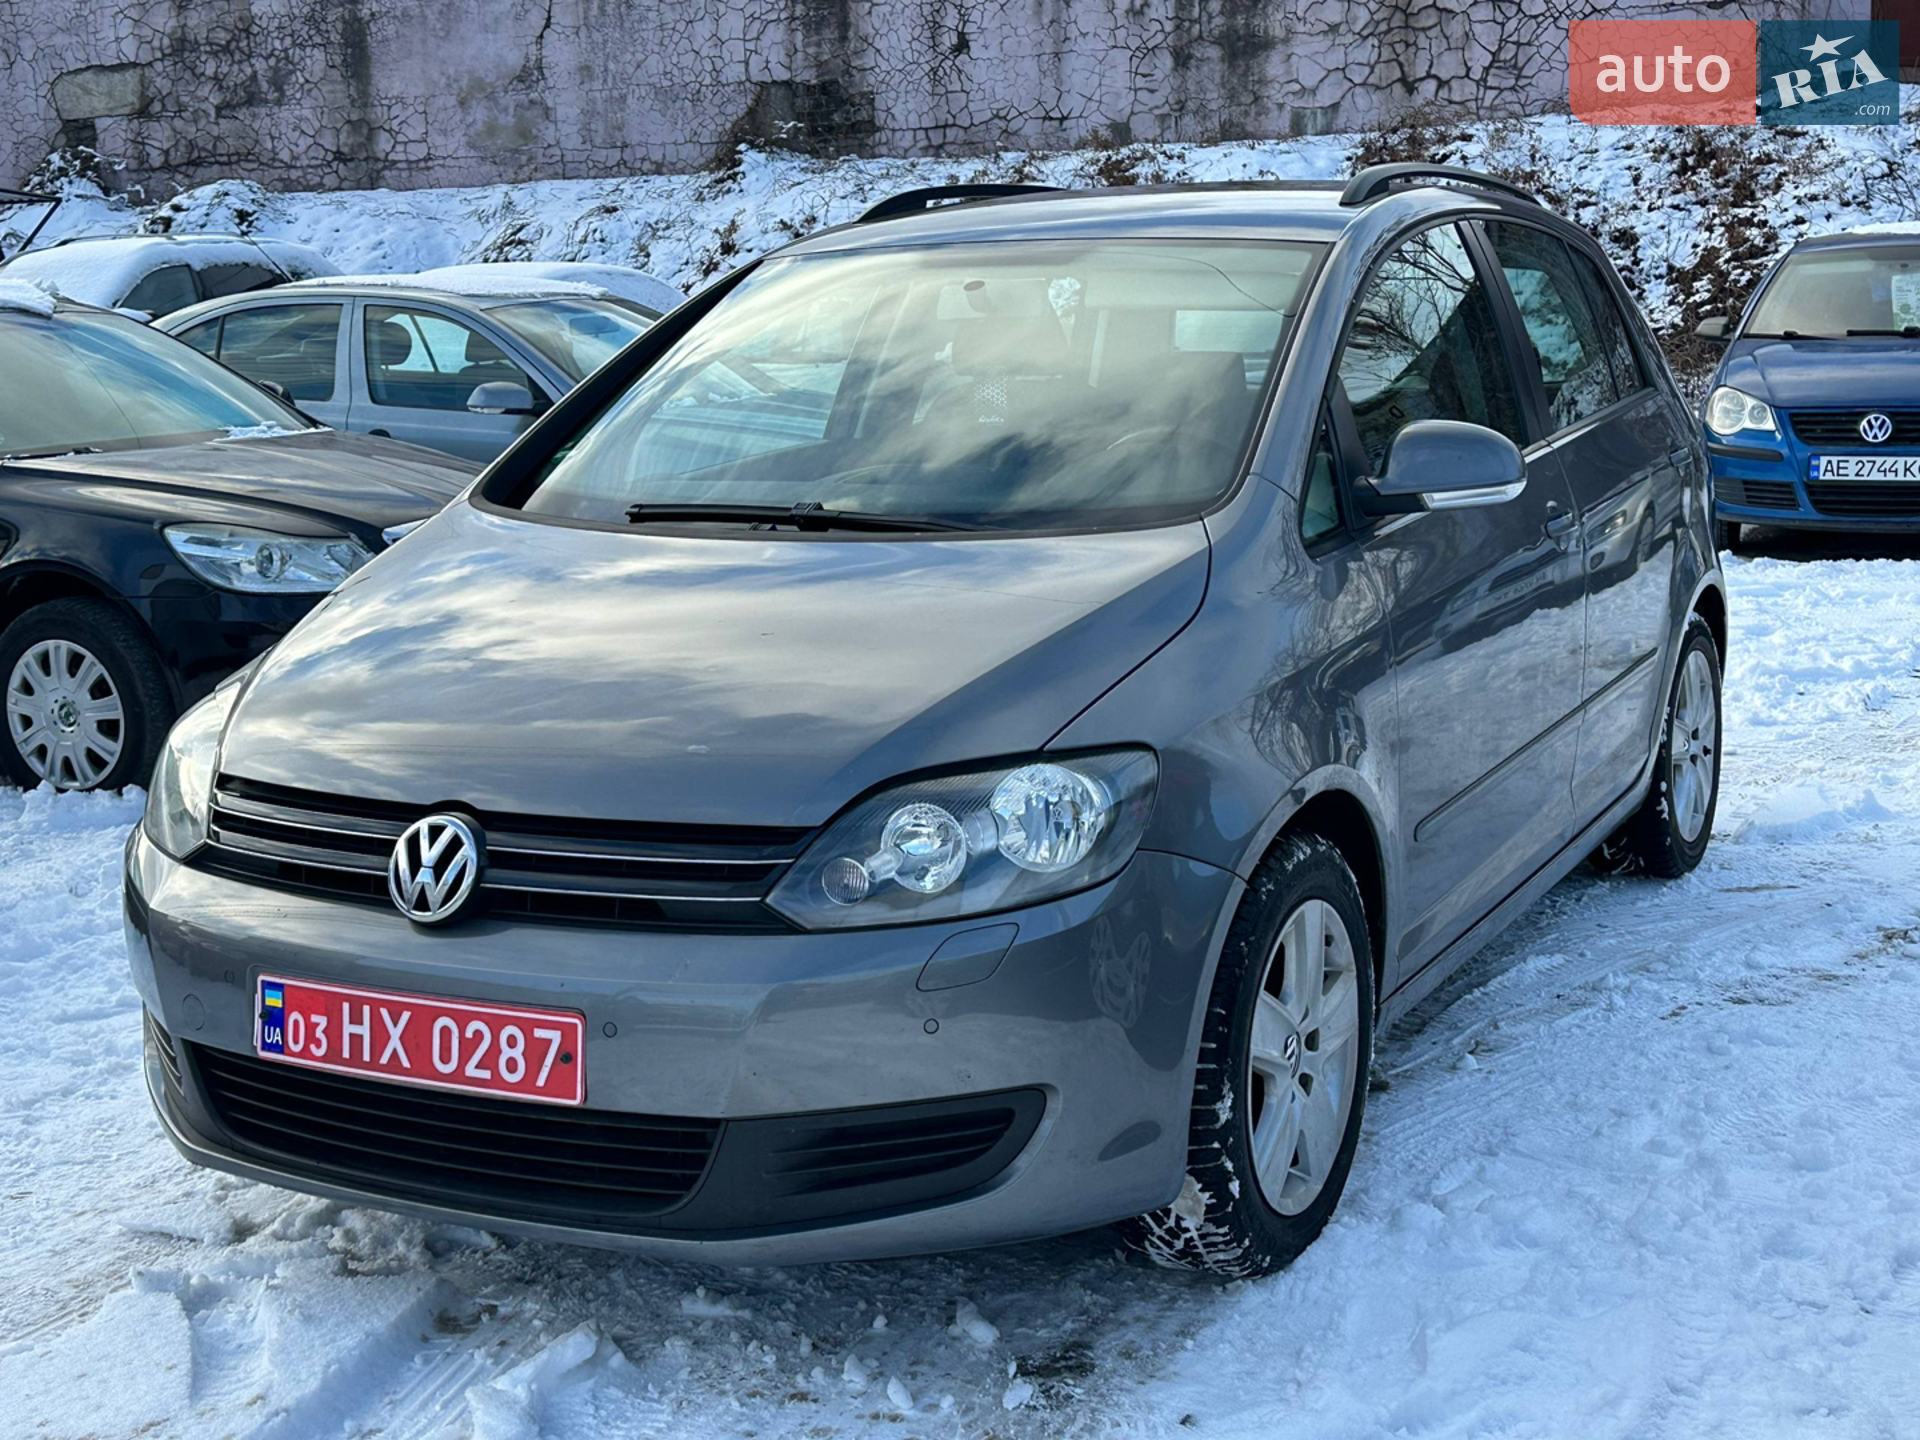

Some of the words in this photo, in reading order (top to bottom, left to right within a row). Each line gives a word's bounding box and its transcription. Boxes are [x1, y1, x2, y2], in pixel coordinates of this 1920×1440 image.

[1822, 459, 1850, 477] AE
[1854, 459, 1899, 478] 2744
[1903, 459, 1920, 478] K
[264, 1024, 283, 1046] UA
[287, 1010, 328, 1058] 03
[342, 1001, 412, 1069] HX
[431, 1015, 562, 1088] 0287
